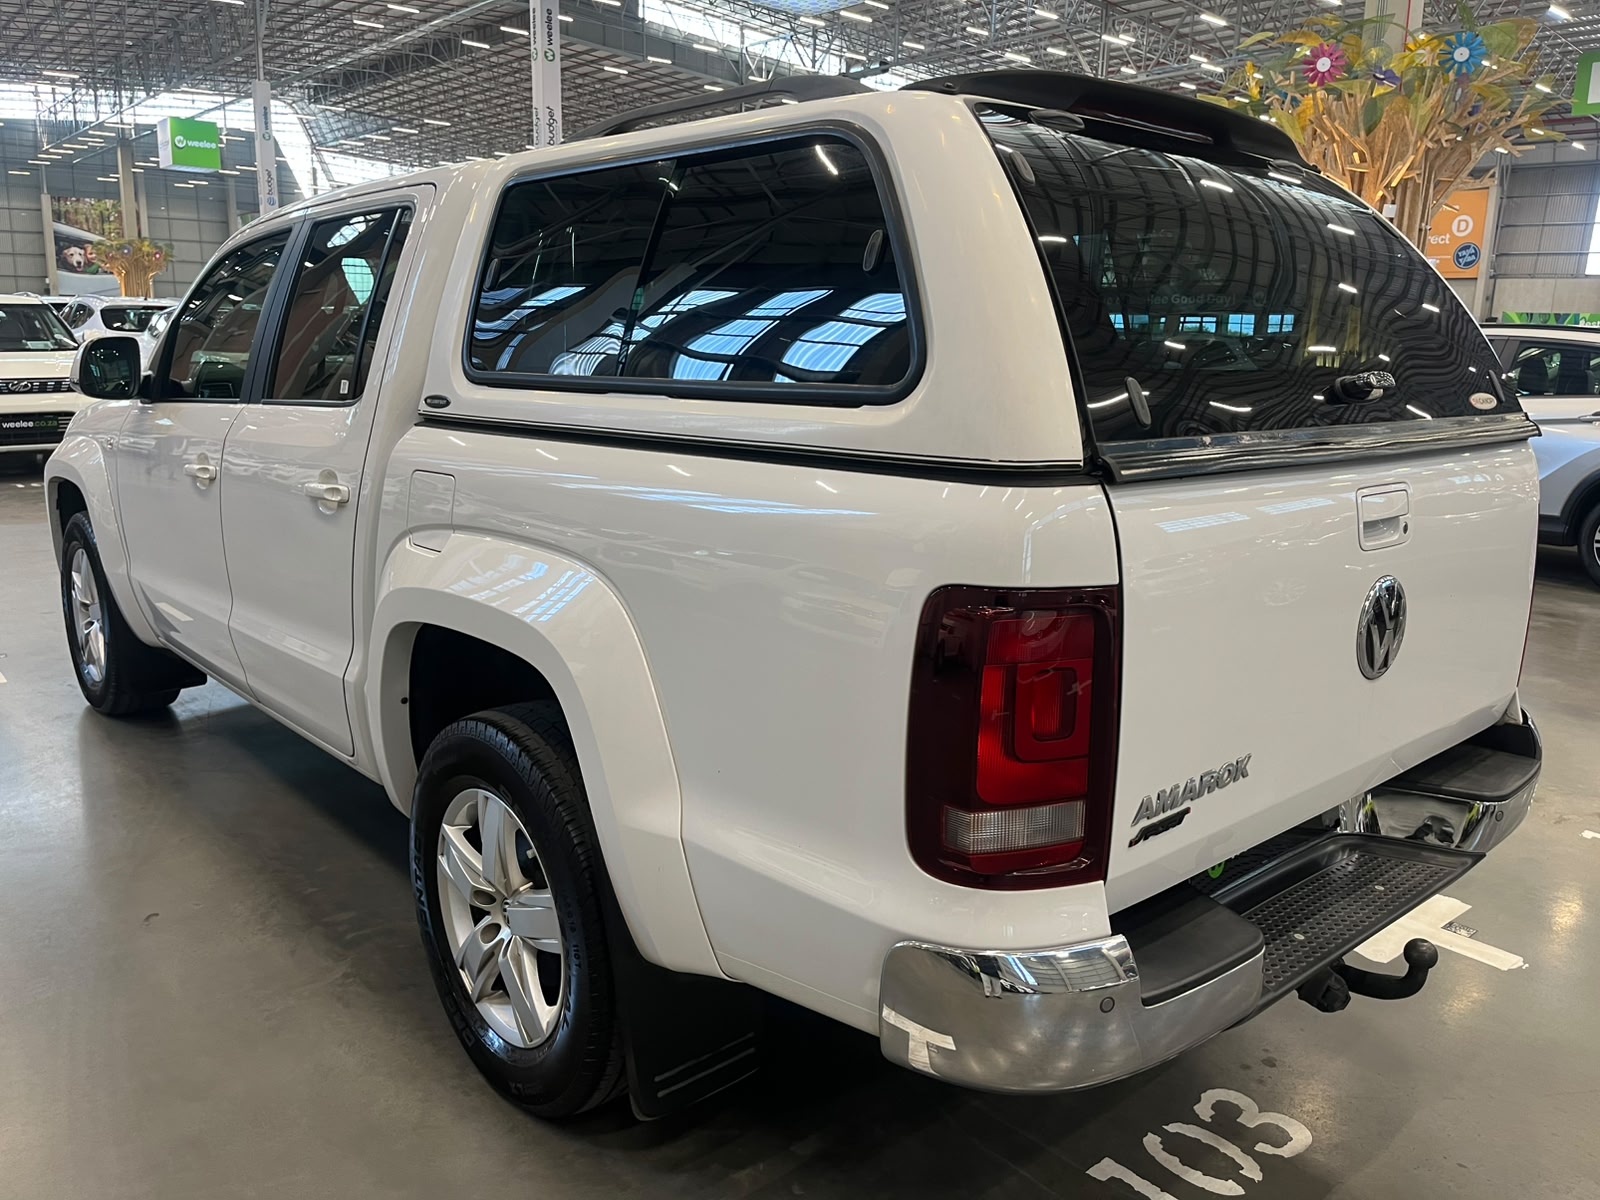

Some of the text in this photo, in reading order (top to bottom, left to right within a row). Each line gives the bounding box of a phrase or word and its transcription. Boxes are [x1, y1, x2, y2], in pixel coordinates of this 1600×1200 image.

[545, 8, 553, 46] weelee
[187, 140, 217, 149] weelee
[546, 106, 558, 146] budget
[266, 168, 276, 196] budget
[1131, 753, 1252, 827] AMAROK
[1086, 1088, 1313, 1200] 103
